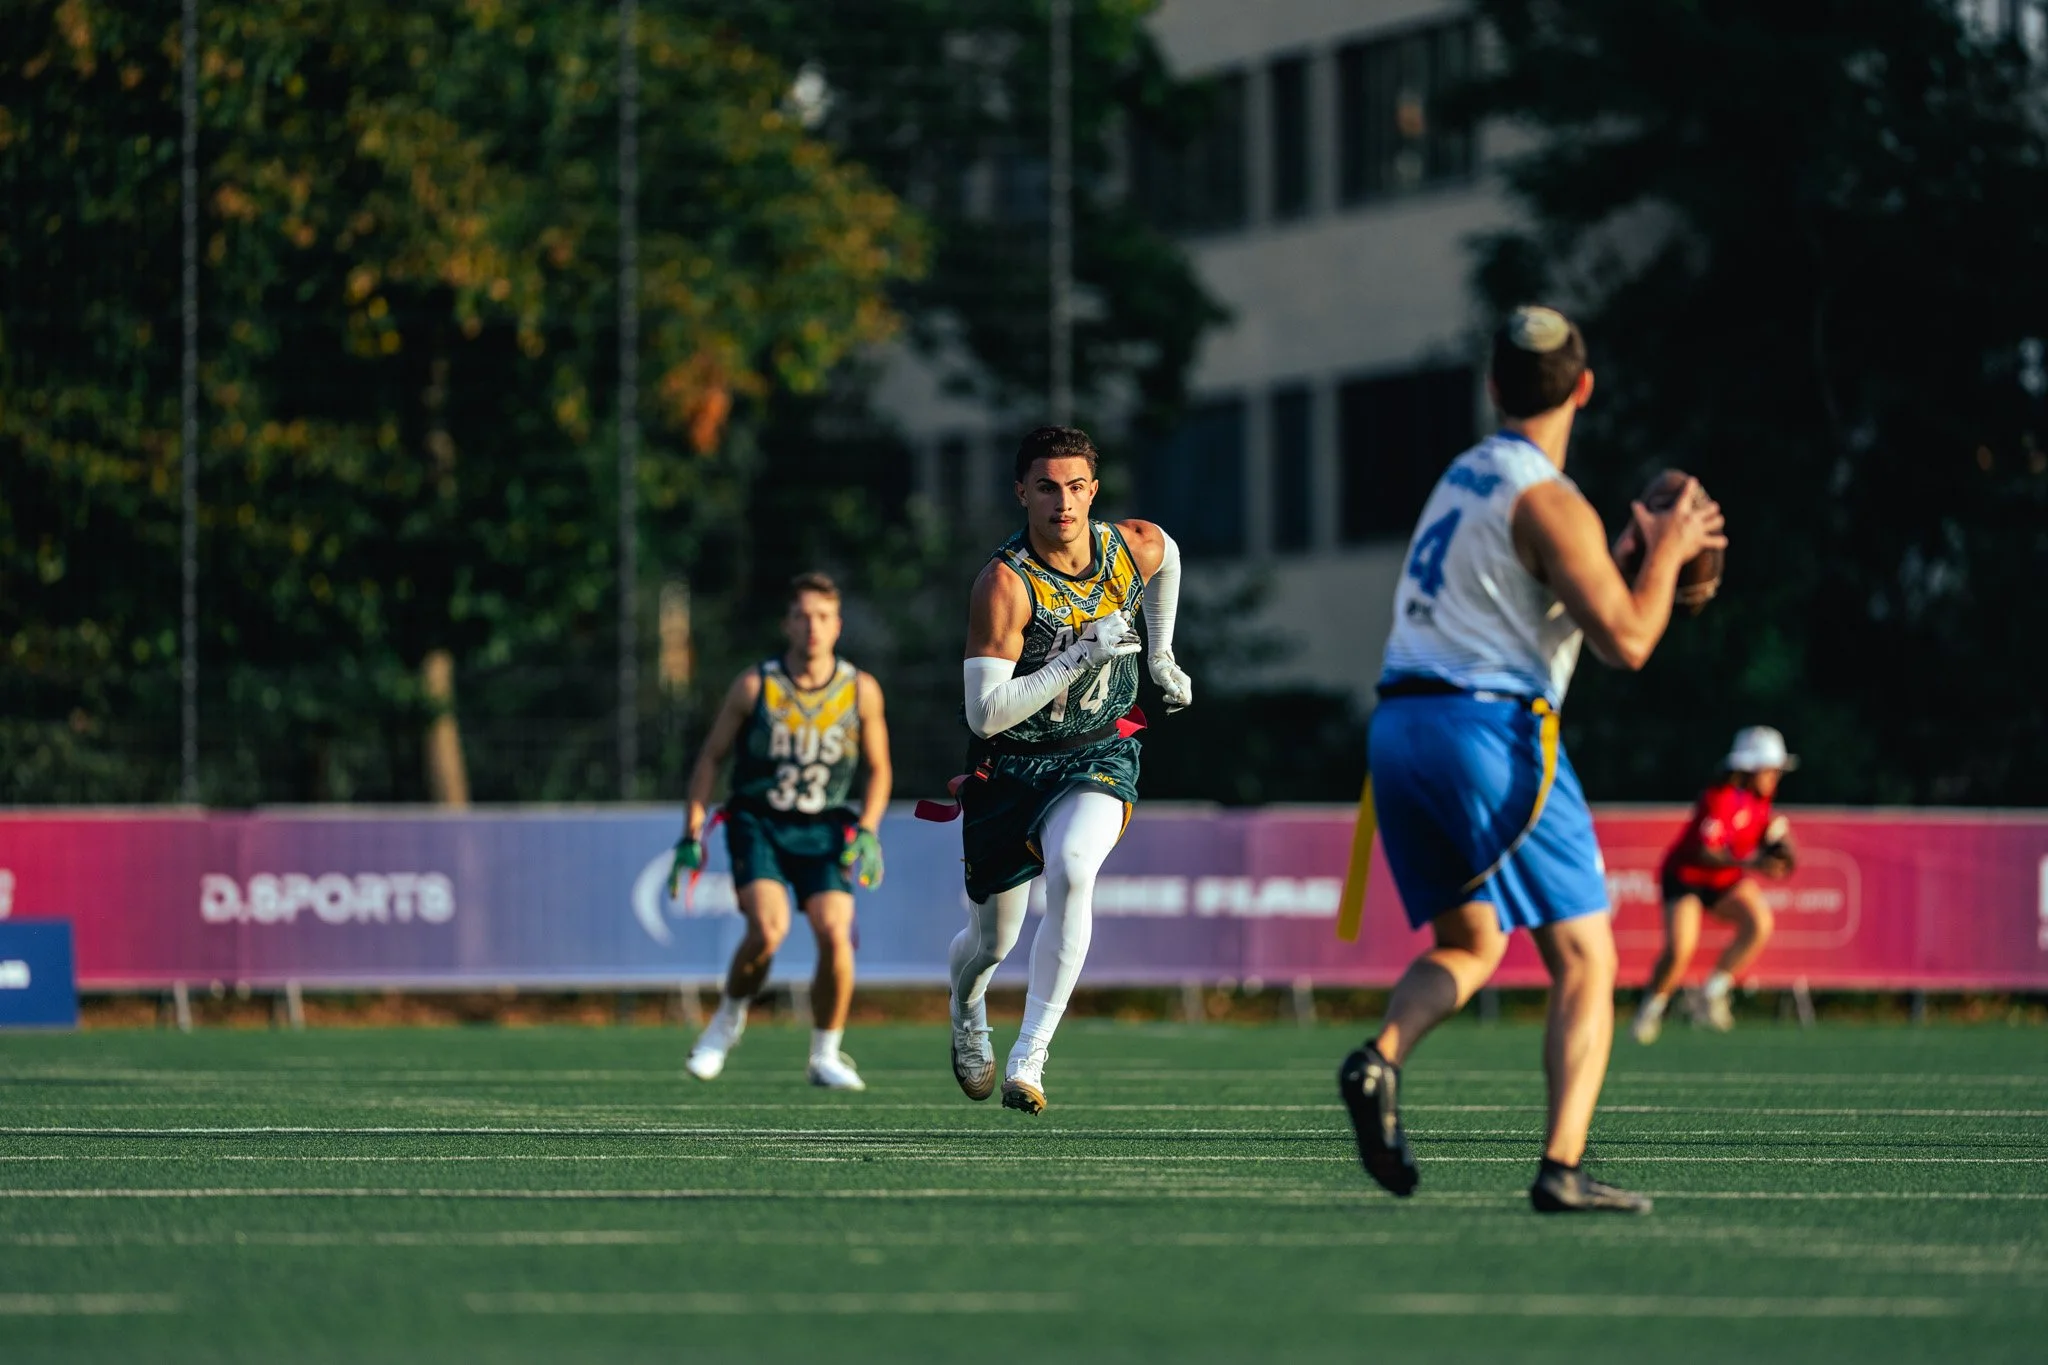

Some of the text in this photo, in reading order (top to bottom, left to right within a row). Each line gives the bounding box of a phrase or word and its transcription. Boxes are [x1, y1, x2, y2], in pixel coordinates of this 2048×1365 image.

[1408, 507, 1462, 599] 4
[769, 722, 845, 765] AUS
[767, 764, 831, 814] 33
[200, 872, 455, 924] D.SPORTS
